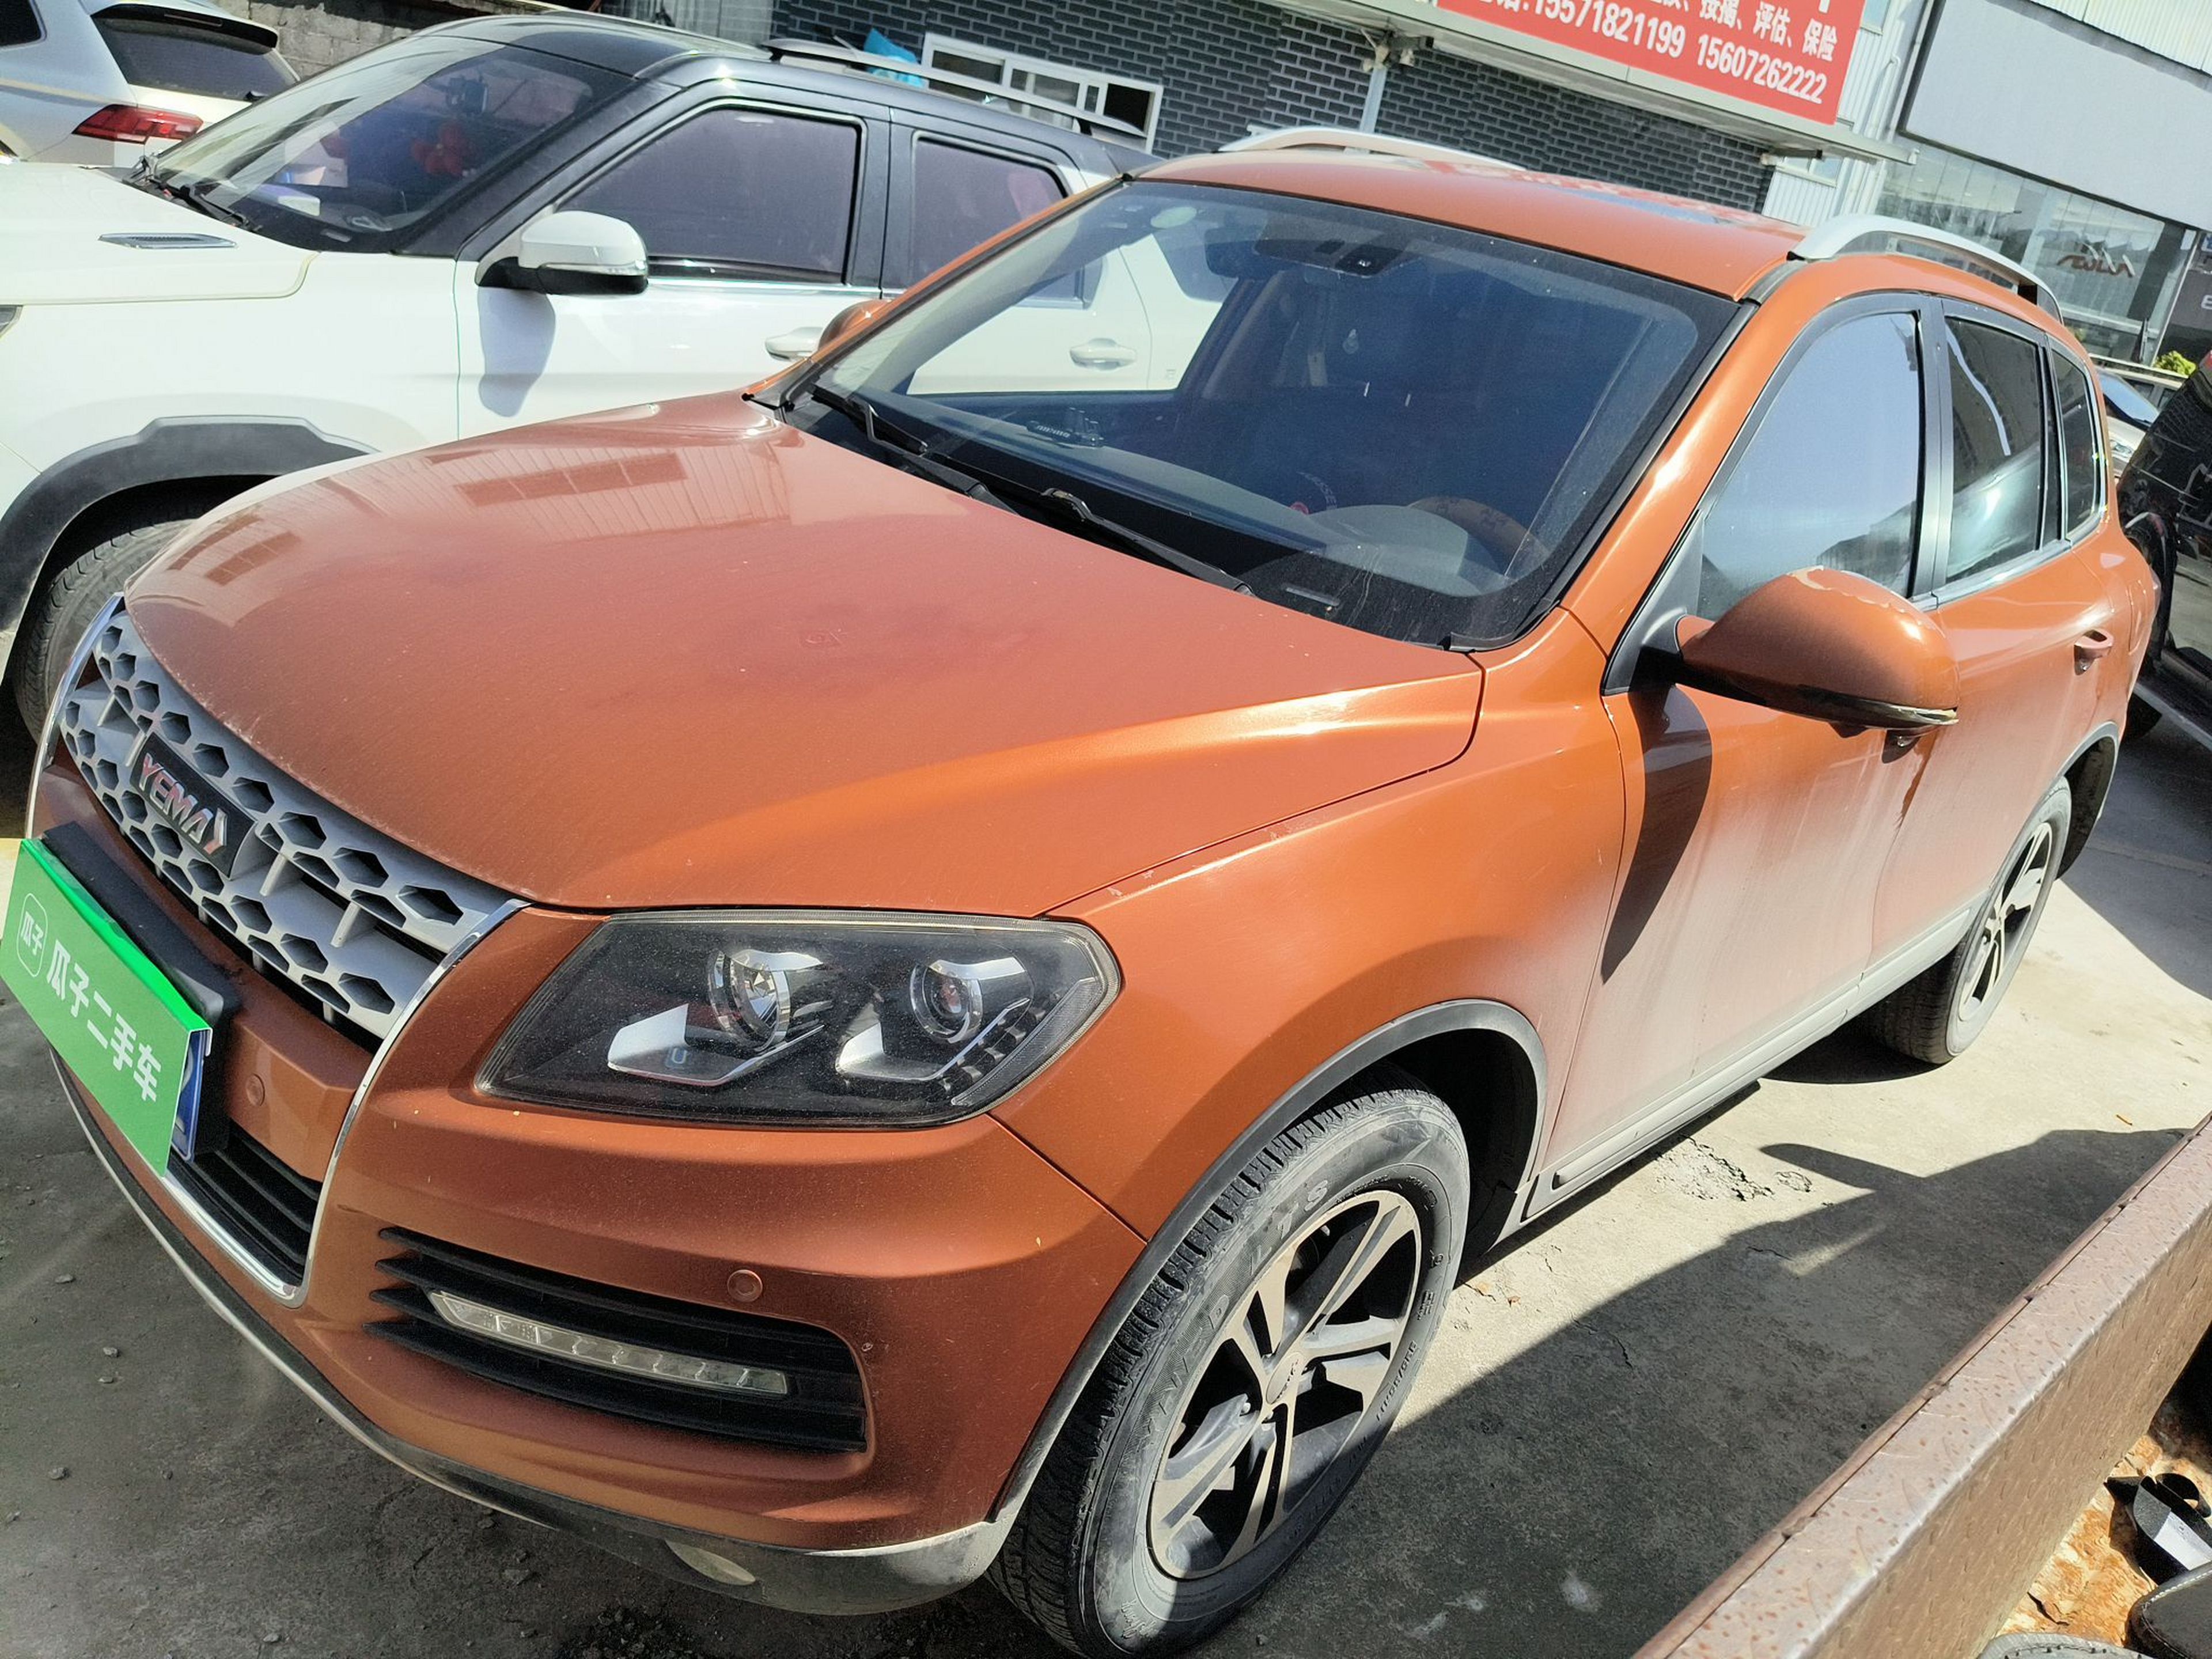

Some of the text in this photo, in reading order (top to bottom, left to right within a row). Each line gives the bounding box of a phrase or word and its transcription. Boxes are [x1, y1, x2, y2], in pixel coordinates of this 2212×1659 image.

[1696, 34, 1827, 104] 15607262222
[139, 752, 214, 844] YEMA
[20, 911, 44, 956] 瓜子
[46, 940, 162, 1103] 瓜子二手车
